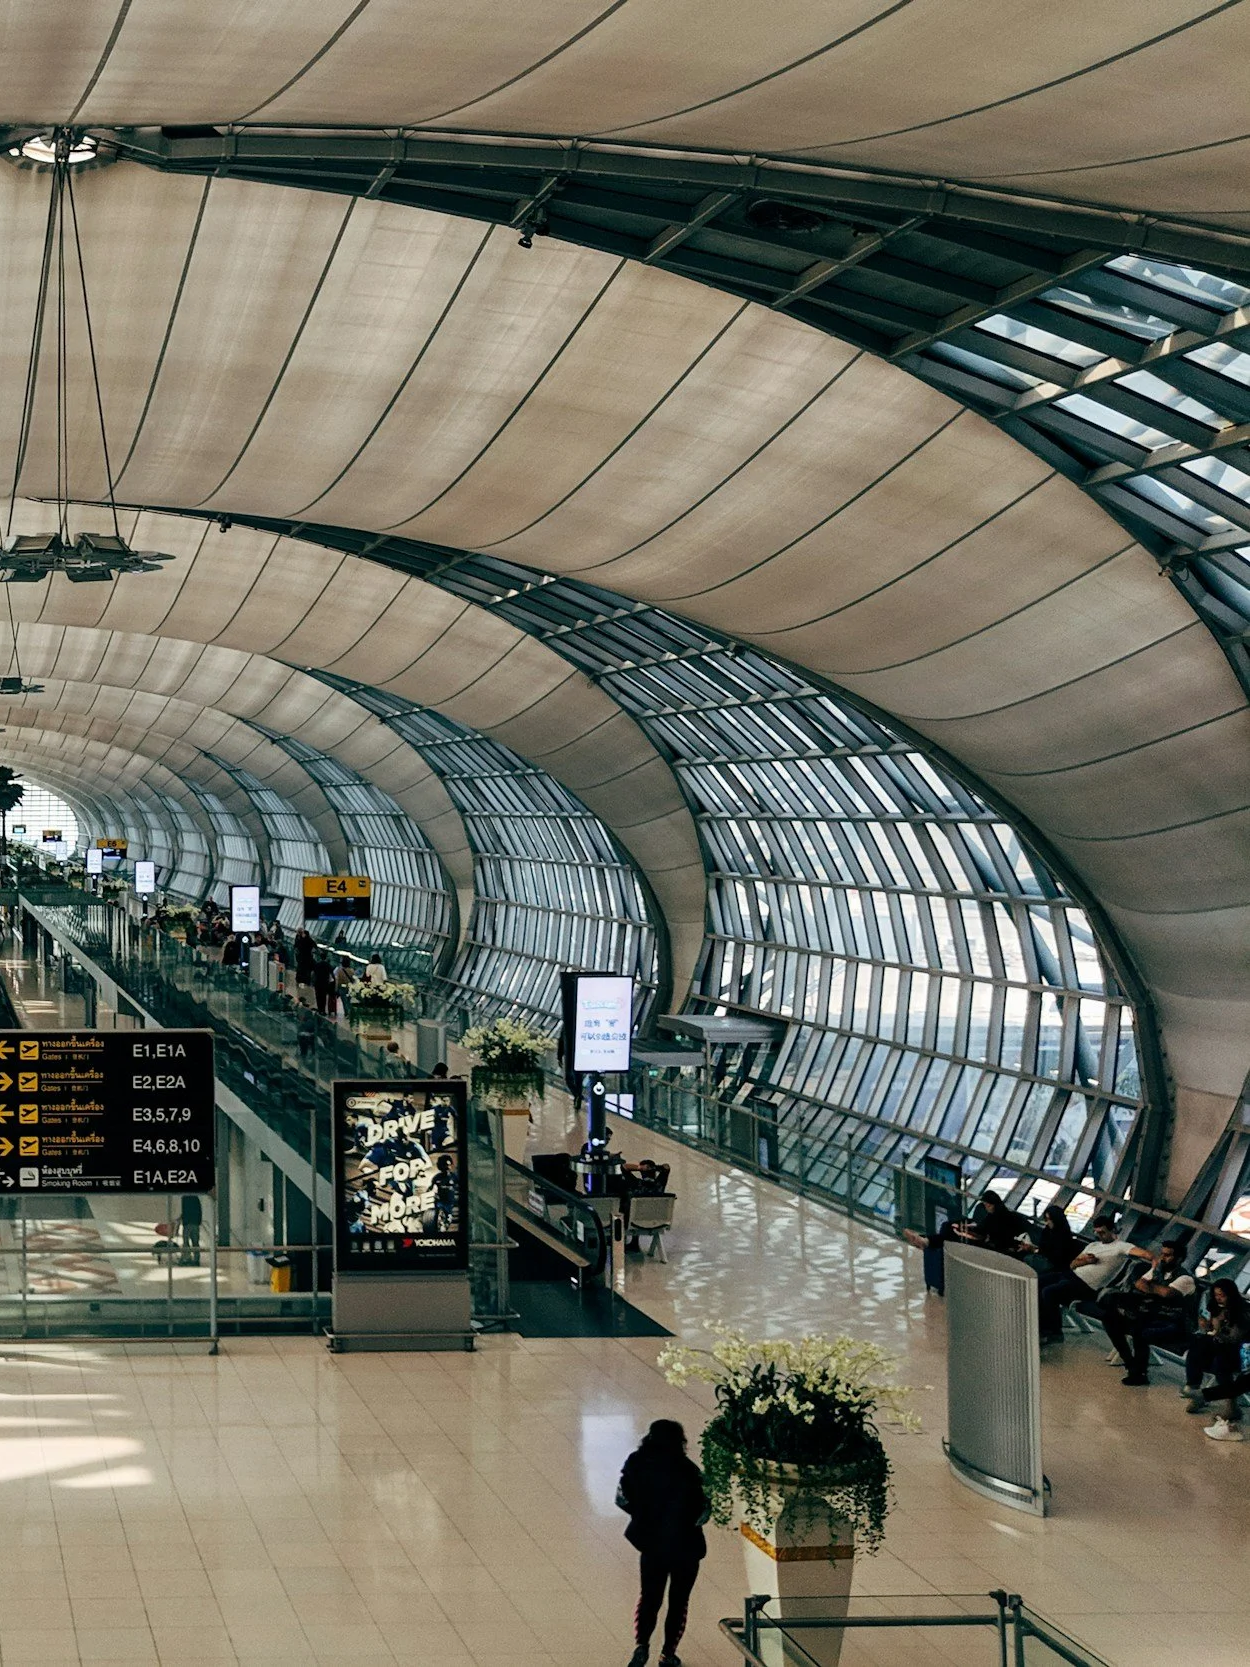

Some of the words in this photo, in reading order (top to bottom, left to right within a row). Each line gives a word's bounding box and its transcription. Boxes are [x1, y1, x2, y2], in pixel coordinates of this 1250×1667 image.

[326, 880, 348, 893] E4
[132, 1044, 187, 1059] E1,E1A
[41, 1084, 61, 1092] Gates
[132, 1075, 186, 1091] E2,E2A
[132, 1108, 191, 1123] E3,5,7,9
[133, 1139, 200, 1154] E4,6,8,10
[41, 1180, 71, 1189] Smoking
[72, 1179, 93, 1187] Room
[133, 1170, 198, 1185] E1A,E2A
[371, 1190, 435, 1224] MORE
[414, 1239, 456, 1247] YOKOHAMA
